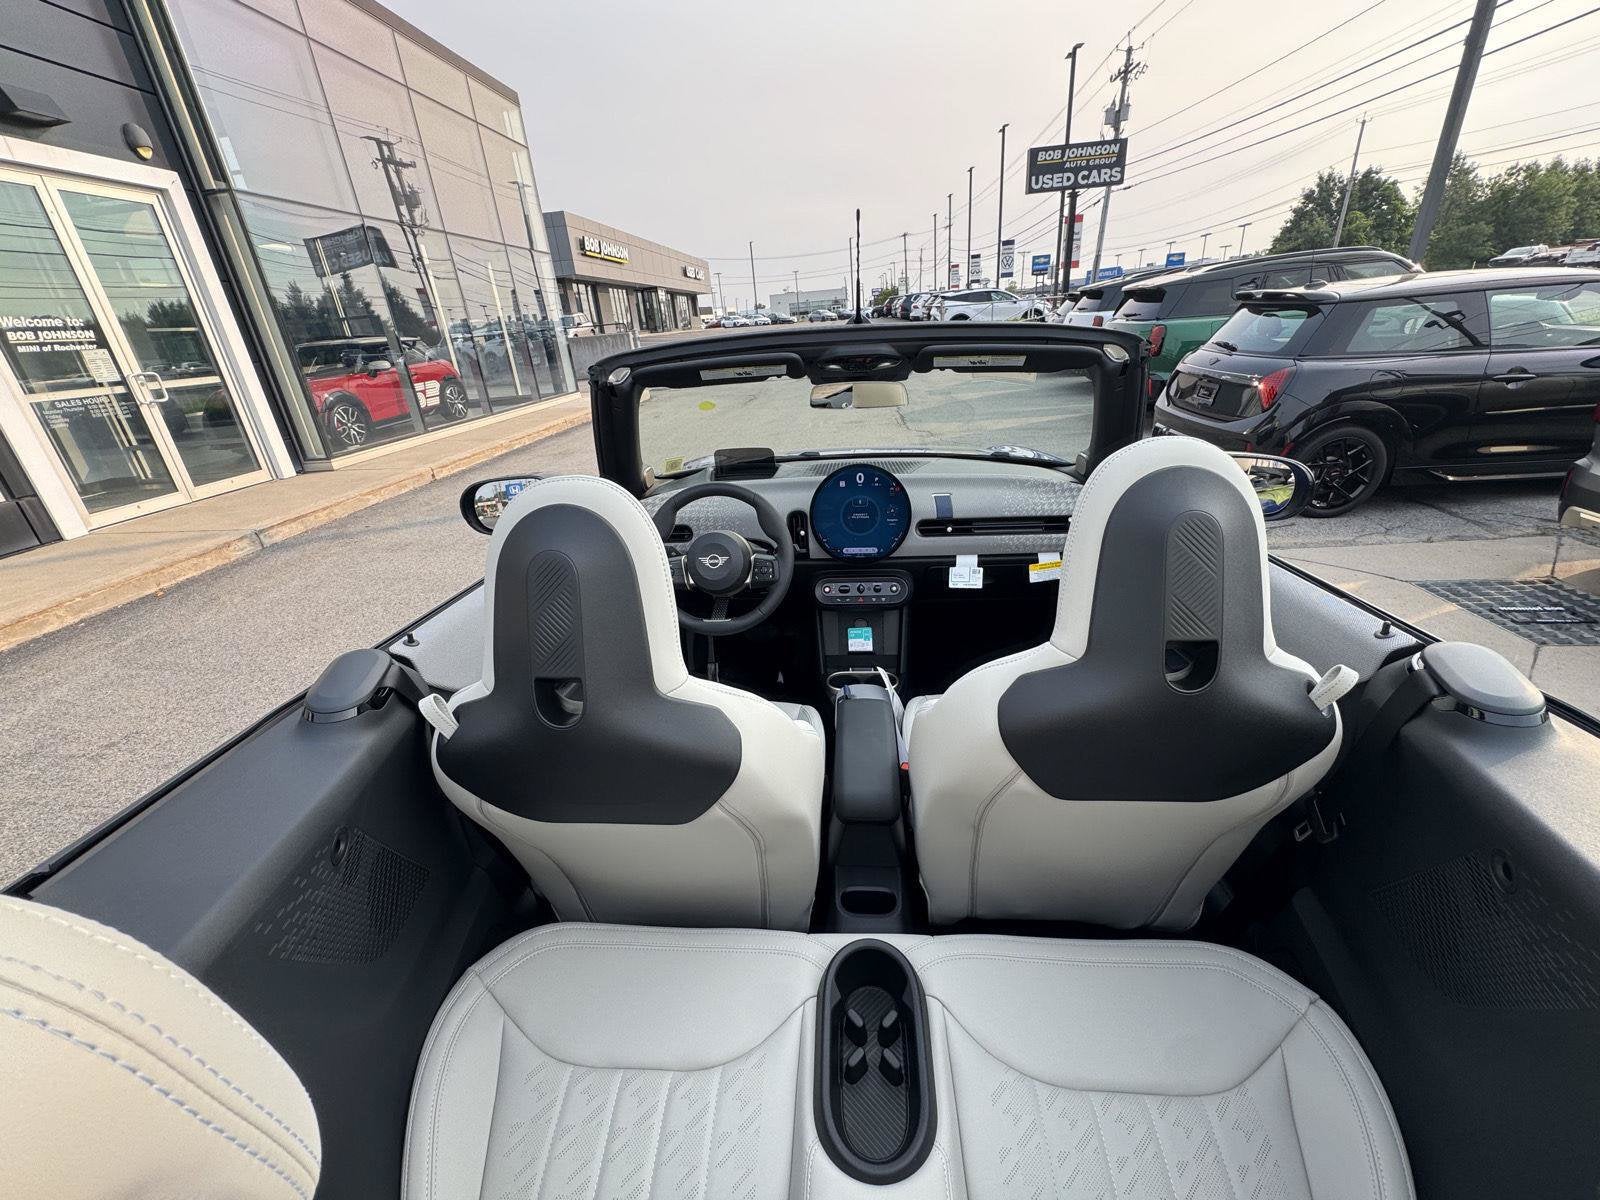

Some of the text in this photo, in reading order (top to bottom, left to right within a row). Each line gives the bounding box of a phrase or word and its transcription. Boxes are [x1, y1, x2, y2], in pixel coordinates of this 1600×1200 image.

[1038, 143, 1120, 161] BOB JOHNSON
[1064, 157, 1117, 168] AUTO GROUP
[1031, 167, 1121, 189] USED CARS
[584, 236, 600, 253] BOB
[0, 315, 84, 328] Welcome to:
[6, 330, 96, 342] BOB JOHNSON
[42, 344, 52, 352] of
[53, 343, 97, 352] Rochester
[54, 399, 82, 408] SALES
